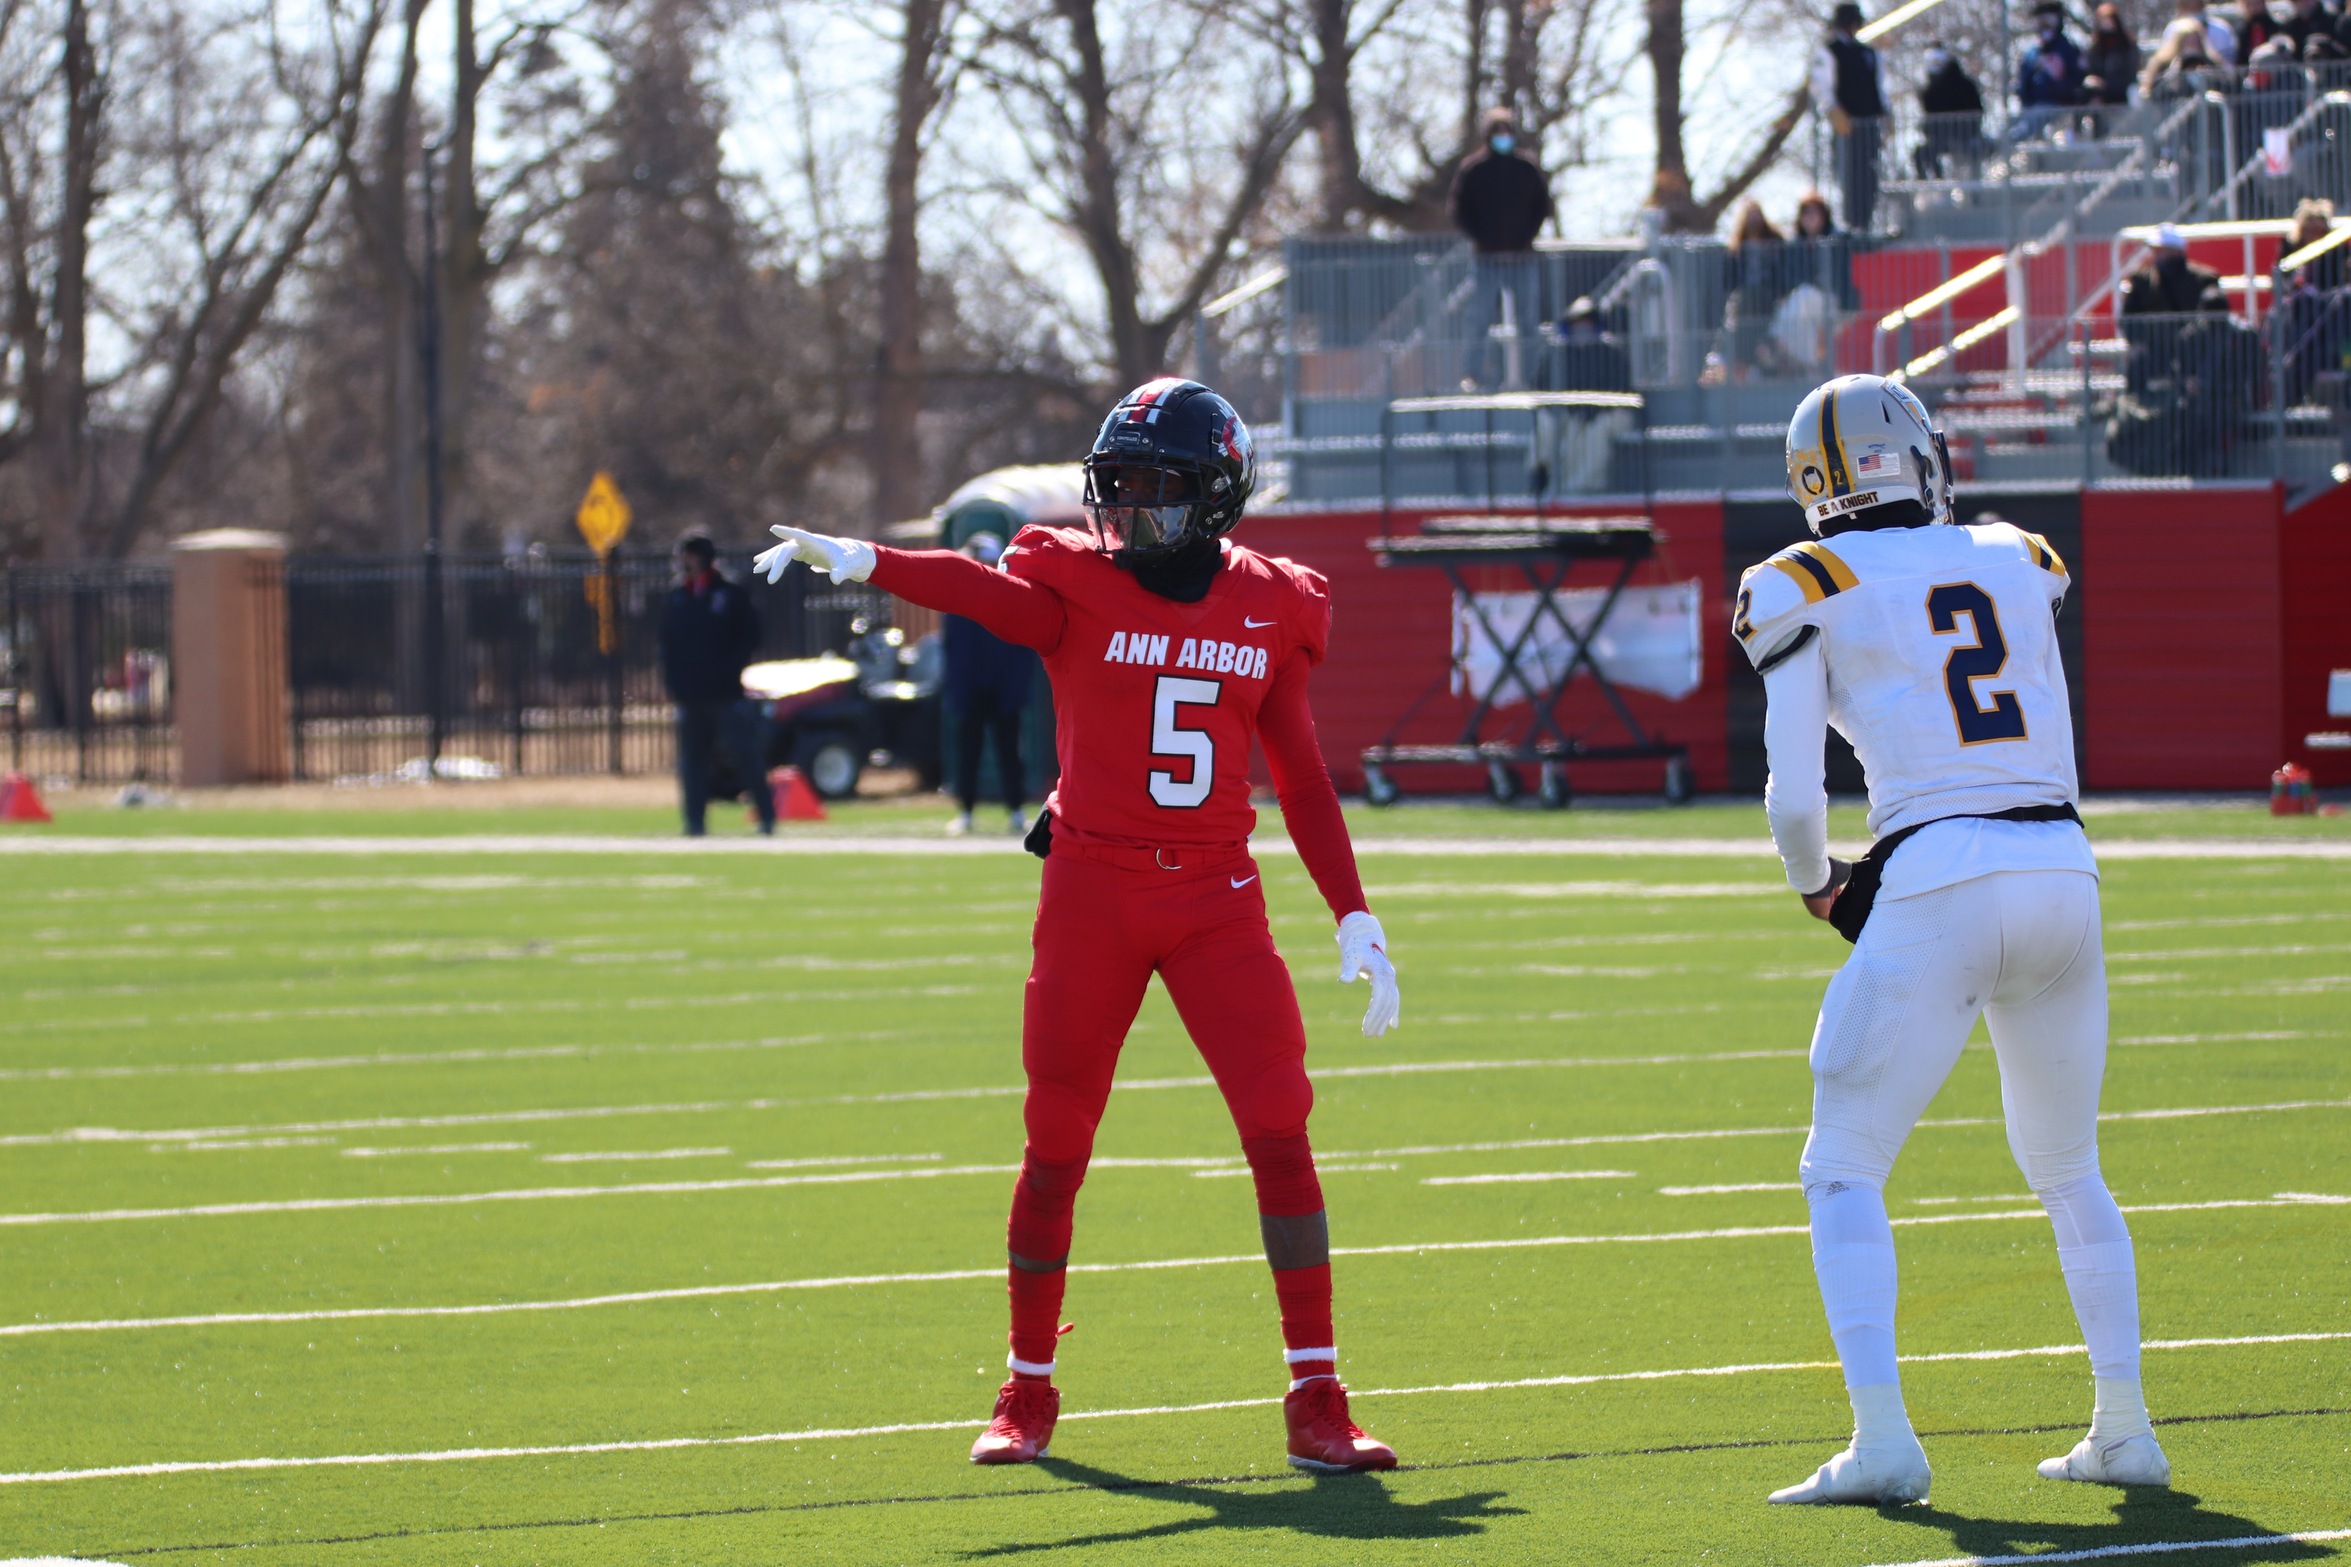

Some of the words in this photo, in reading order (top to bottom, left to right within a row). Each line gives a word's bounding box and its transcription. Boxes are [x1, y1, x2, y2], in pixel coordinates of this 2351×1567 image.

[1817, 503, 1829, 516] BE
[1831, 502, 1839, 512] A
[1839, 491, 1879, 510] KNIGHT
[1834, 470, 1843, 485] 2
[1737, 587, 1758, 644] 2
[1103, 631, 1170, 666] ANN
[1175, 638, 1268, 680] ARBOR
[1924, 580, 2029, 747] 2
[1146, 673, 1223, 809] 5
